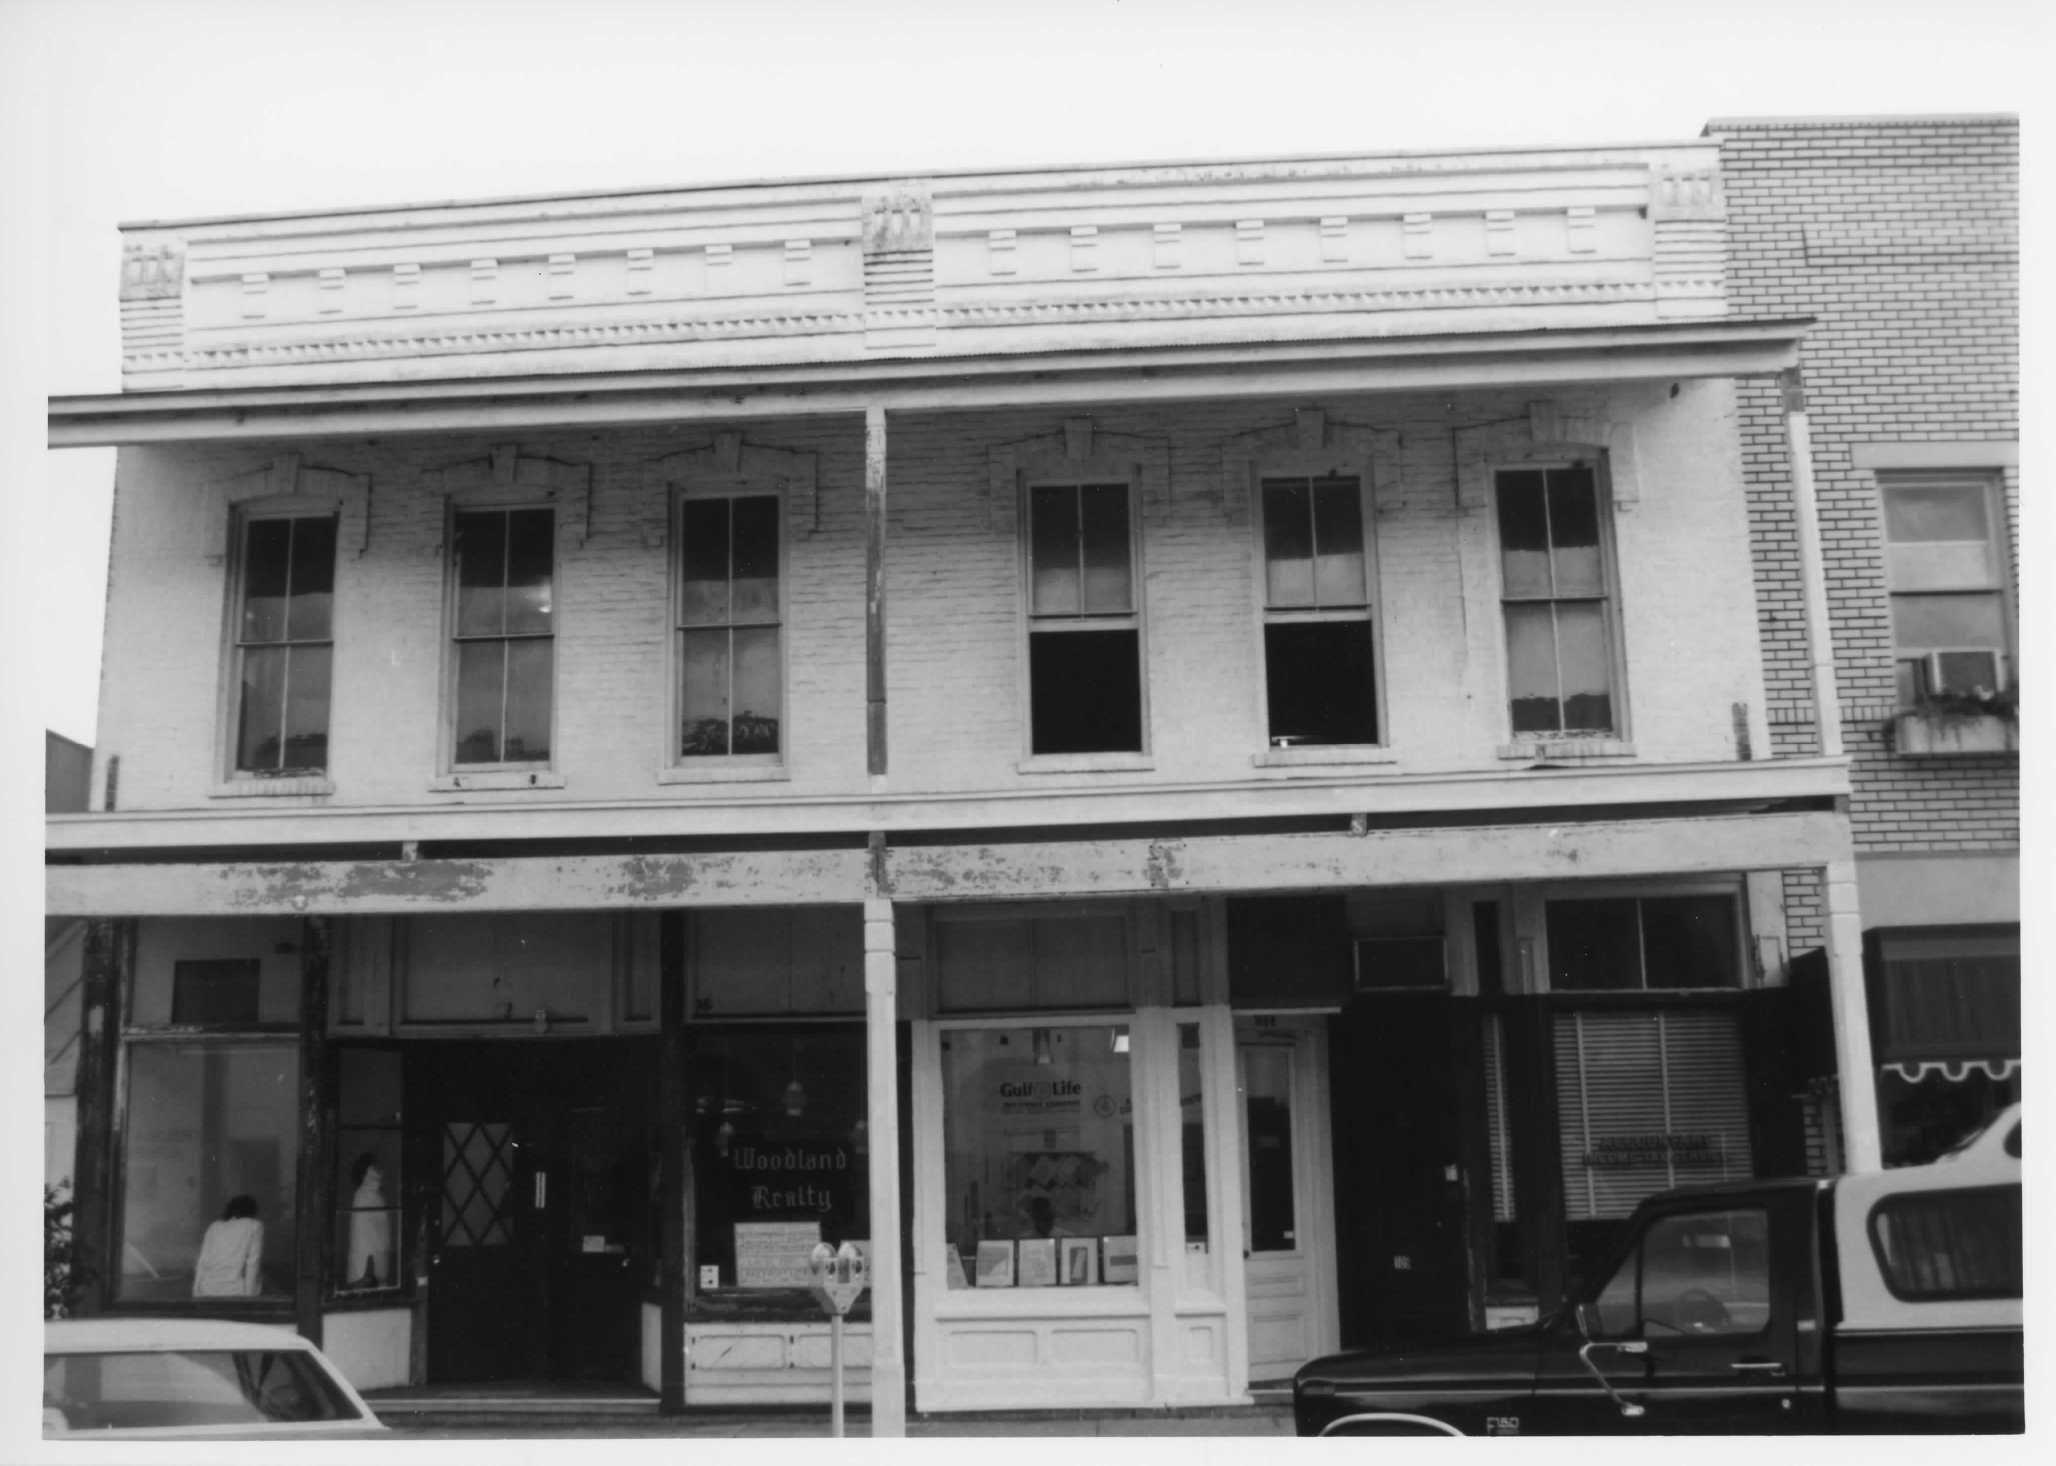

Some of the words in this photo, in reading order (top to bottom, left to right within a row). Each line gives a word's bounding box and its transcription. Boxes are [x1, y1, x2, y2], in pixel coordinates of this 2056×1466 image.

[1000, 1081, 1034, 1097] Gulf
[1051, 1080, 1081, 1096] Life
[732, 1146, 848, 1171] Woodland
[750, 1184, 833, 1214] Realty
